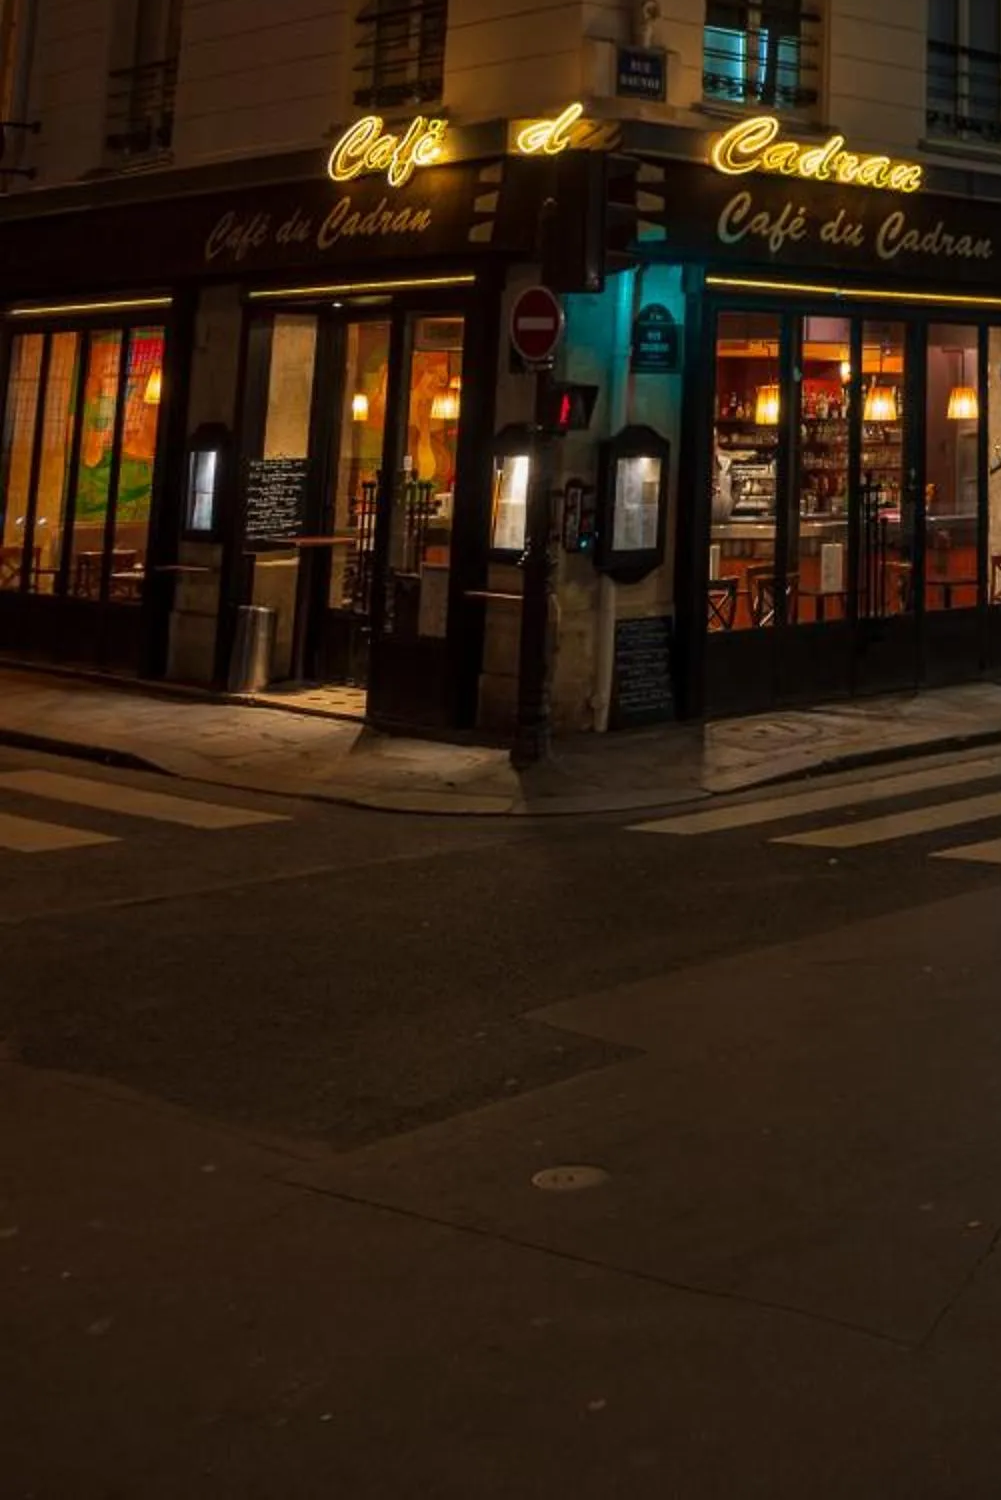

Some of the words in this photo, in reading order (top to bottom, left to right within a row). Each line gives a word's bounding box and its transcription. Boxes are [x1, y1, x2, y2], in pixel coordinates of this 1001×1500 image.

[328, 115, 446, 187] Café
[712, 115, 922, 193] Cadran
[205, 211, 270, 260] Café
[276, 209, 312, 243] du
[317, 196, 431, 249] Cadran
[717, 191, 806, 253] Café
[820, 210, 864, 247] du
[876, 211, 993, 260] Cadran
